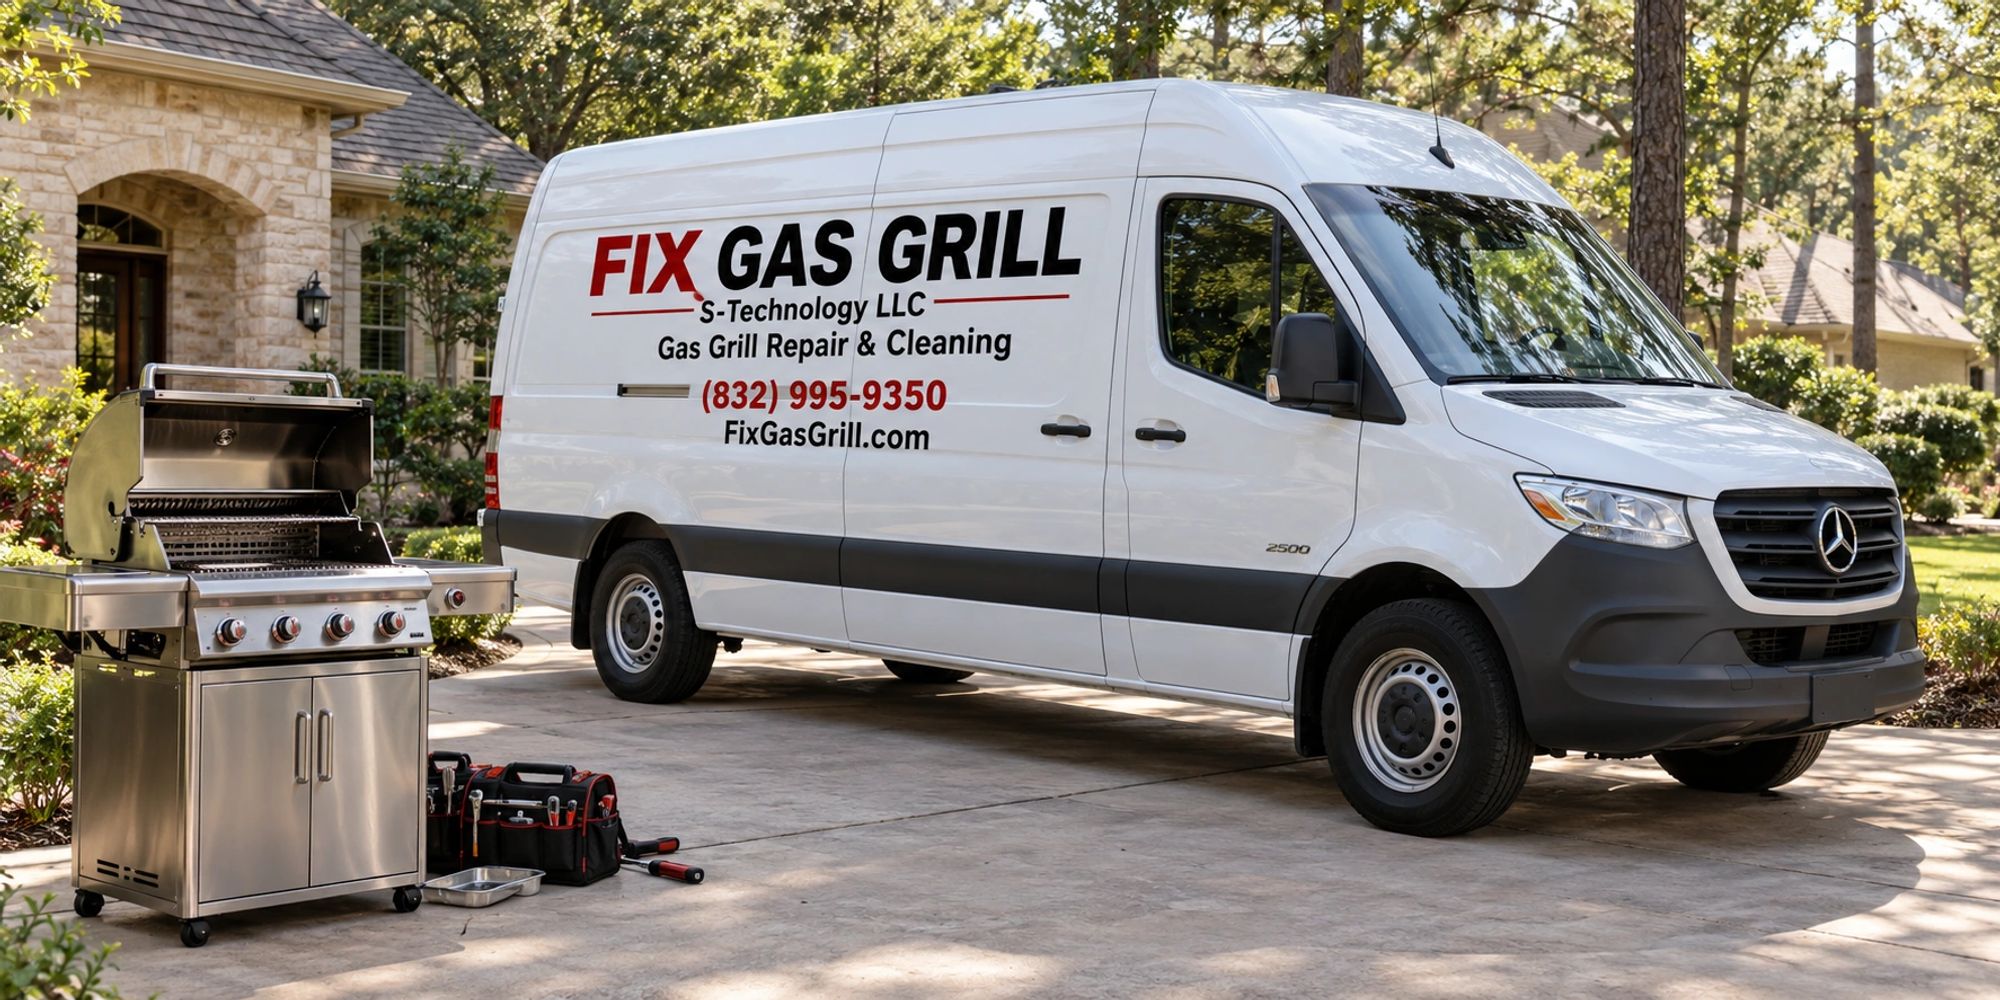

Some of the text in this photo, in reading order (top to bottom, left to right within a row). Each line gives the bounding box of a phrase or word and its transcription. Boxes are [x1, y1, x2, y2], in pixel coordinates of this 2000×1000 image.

[589, 206, 1082, 297] FIX GAS GRILL
[699, 291, 926, 325] S-Technology LLC
[658, 326, 1012, 364] Gas Grill Repair & Cleaning
[702, 379, 947, 415] (832) 995-9350
[724, 420, 930, 451] FixGasGrill.com
[1265, 543, 1311, 555] 2500
